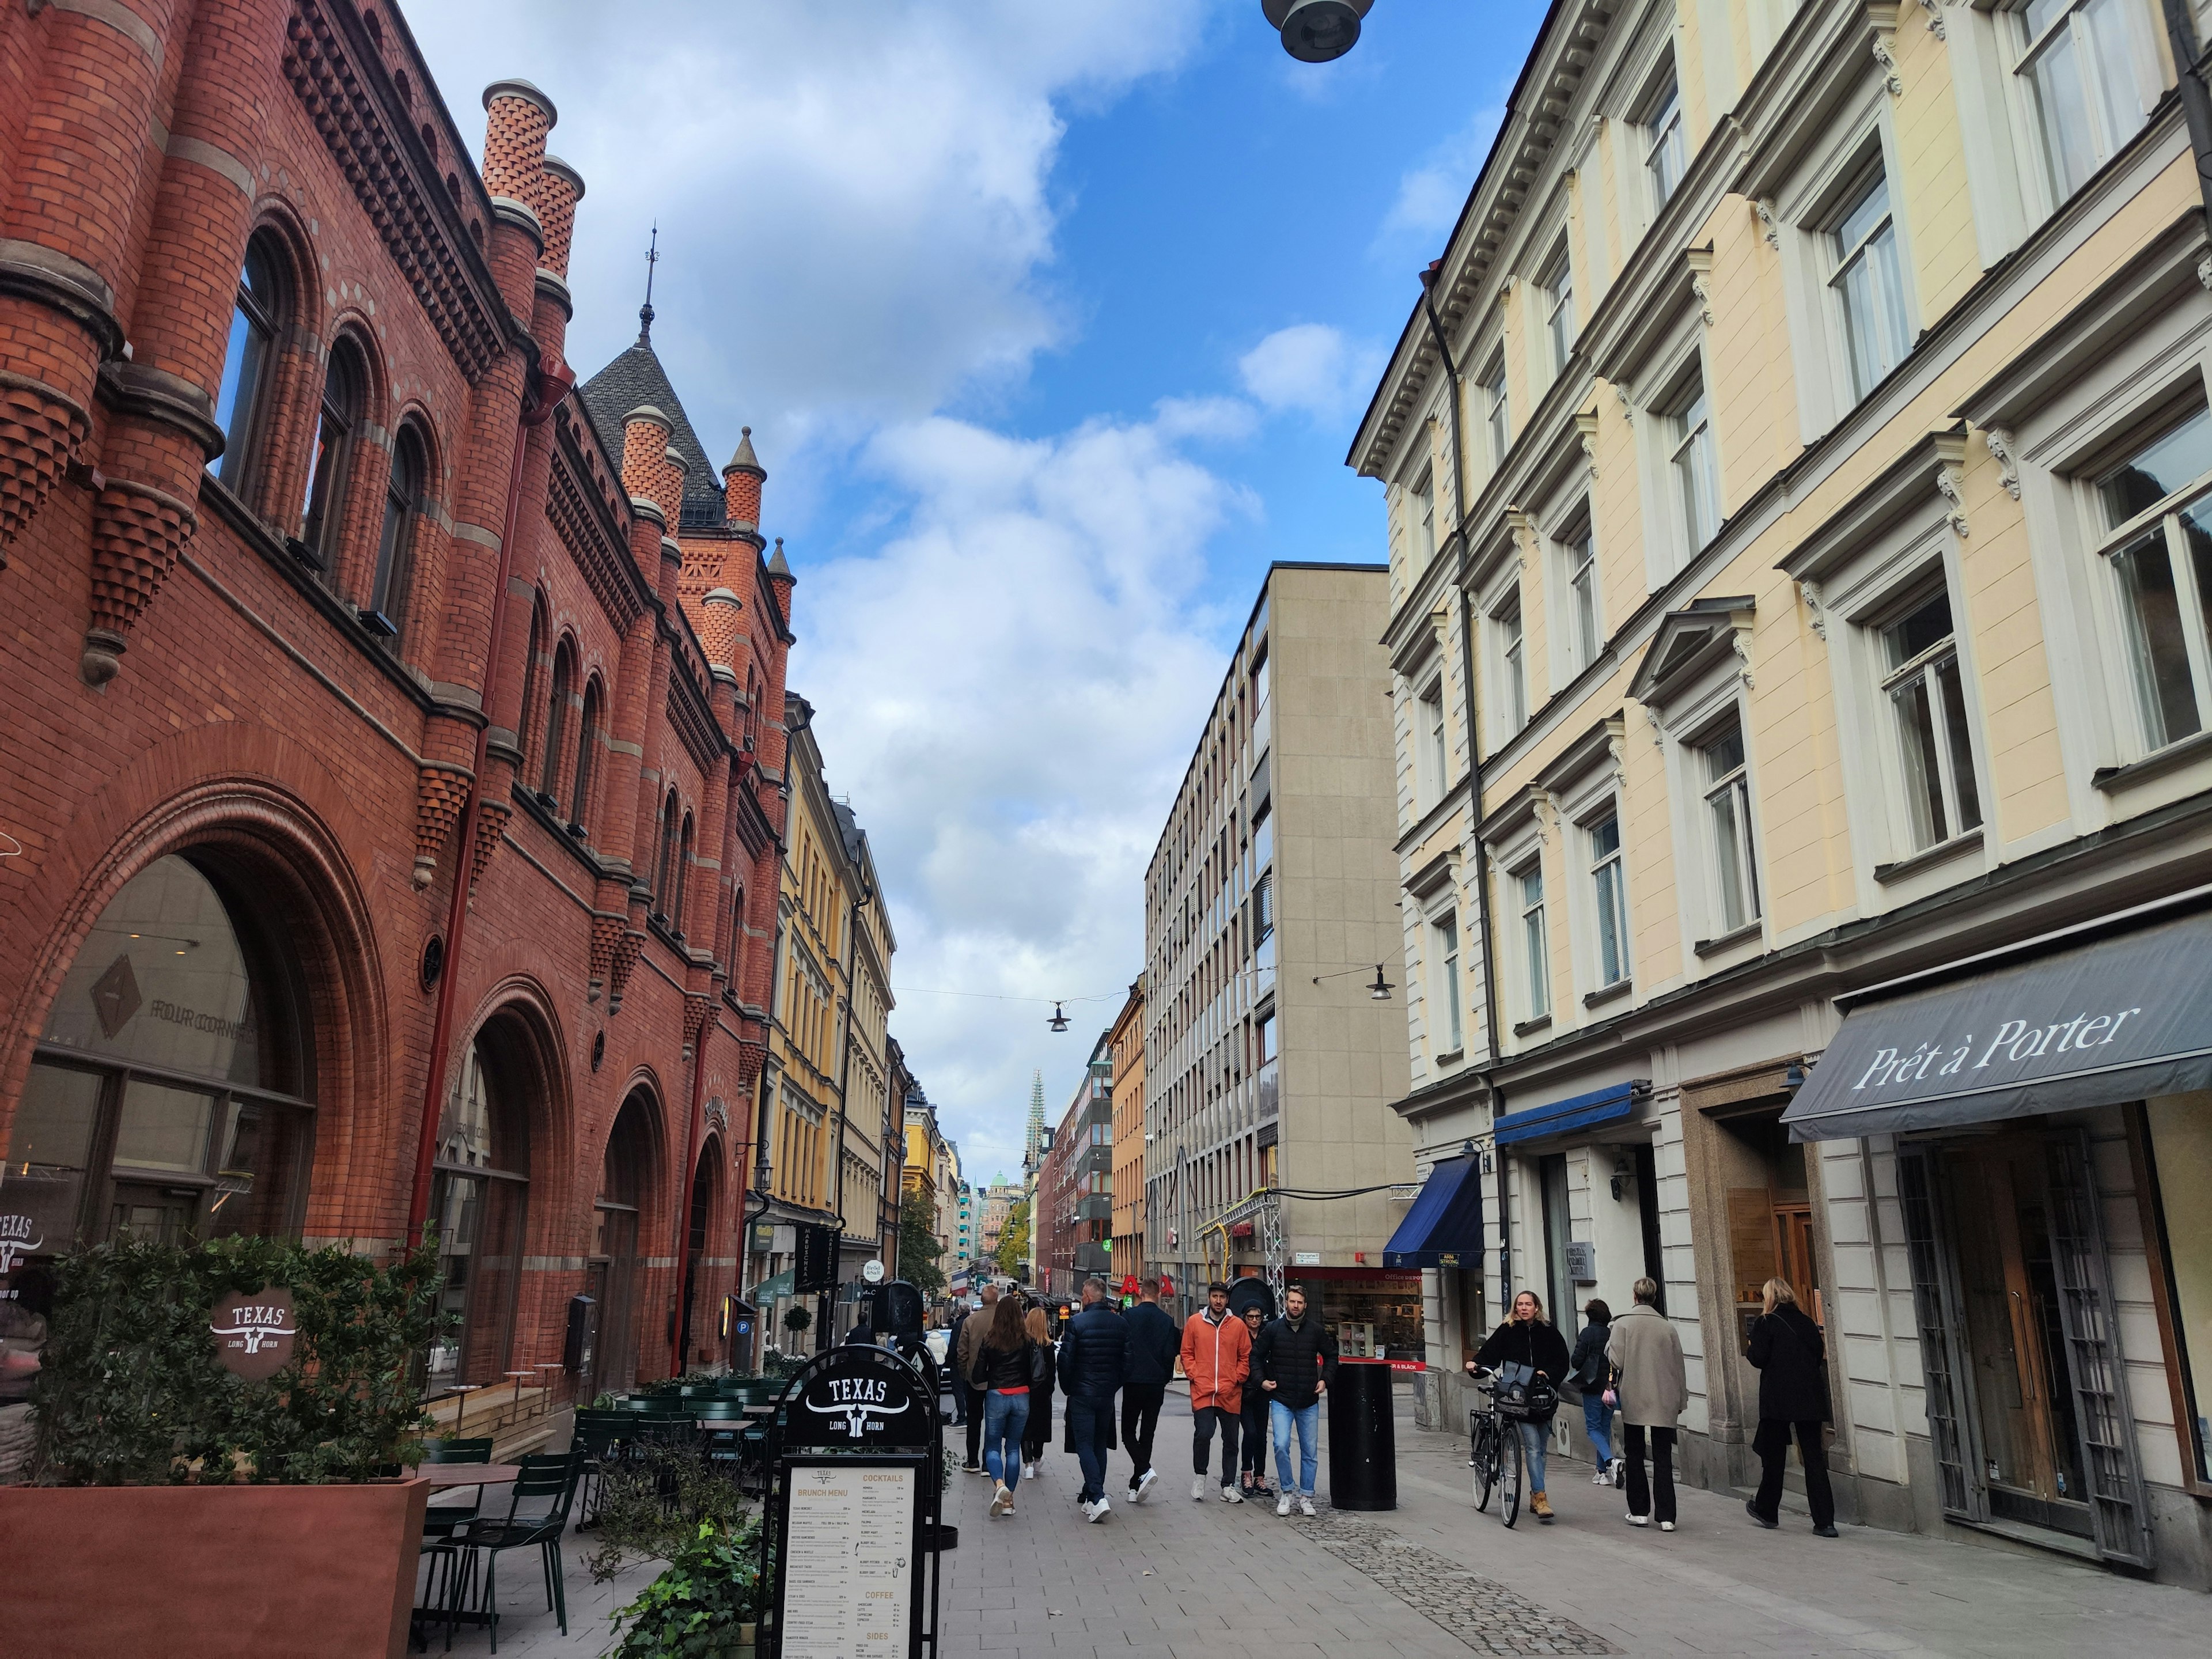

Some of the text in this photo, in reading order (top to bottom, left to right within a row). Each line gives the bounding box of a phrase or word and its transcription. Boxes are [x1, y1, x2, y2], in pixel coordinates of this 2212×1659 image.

[1851, 1007, 2142, 1090] Prêt à Porter
[0, 1214, 32, 1239] EXAS
[802, 1228, 811, 1277] MARUSCHKA
[232, 1306, 285, 1325] TEXAS
[740, 1323, 747, 1332] P
[228, 1340, 244, 1348] LONG
[828, 1378, 887, 1402] TEXAS
[830, 1421, 885, 1431] LONG HORN
